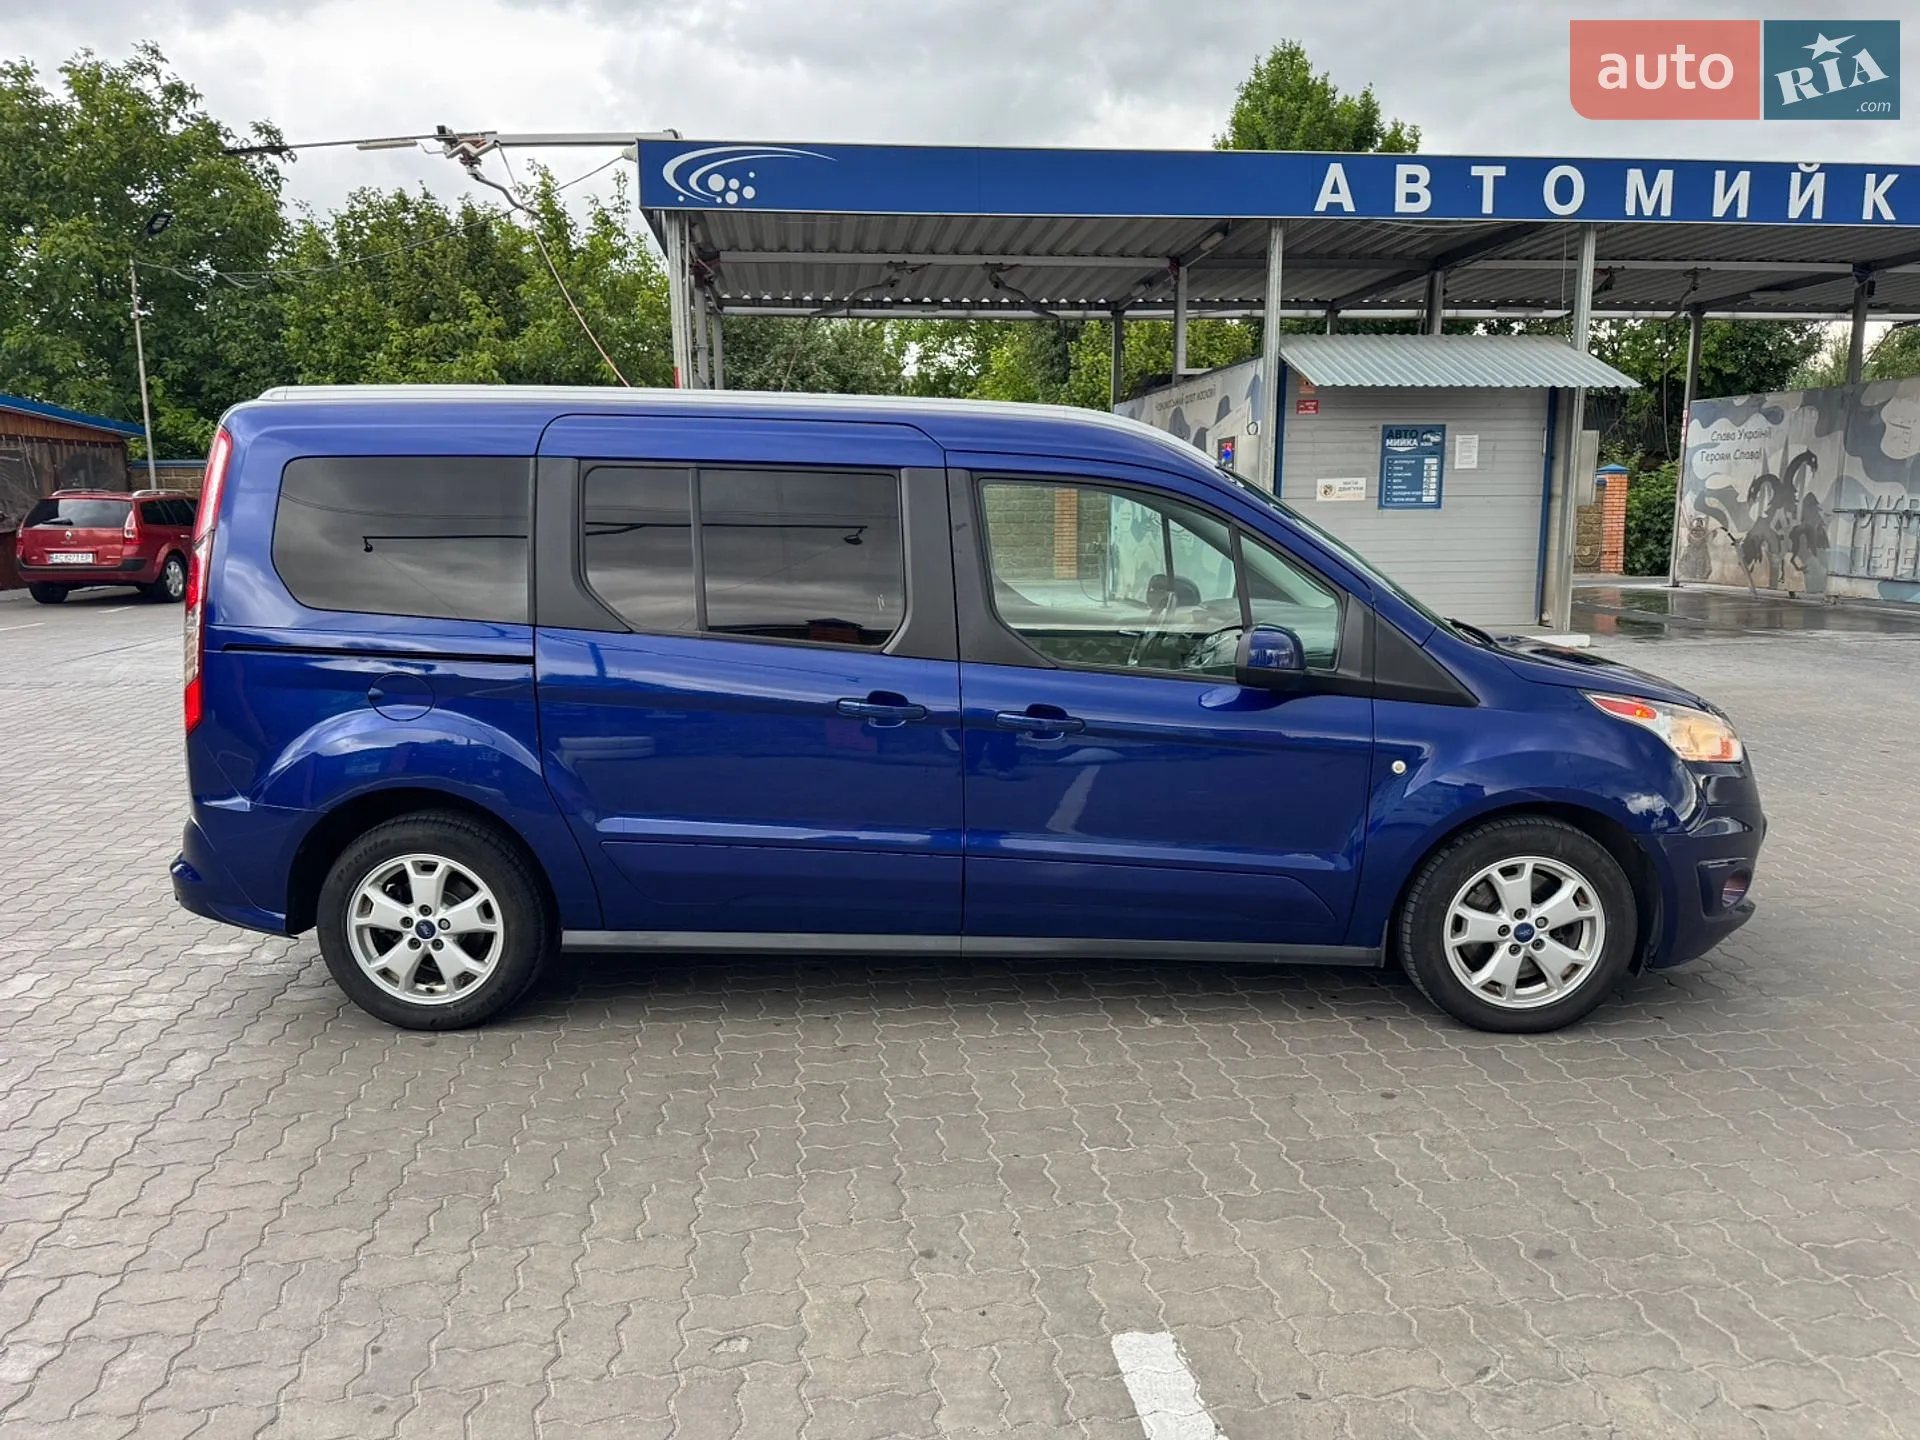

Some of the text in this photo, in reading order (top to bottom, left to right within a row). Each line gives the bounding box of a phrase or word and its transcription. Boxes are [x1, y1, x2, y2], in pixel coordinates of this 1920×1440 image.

[1386, 429, 1419, 440] АВТО
[1711, 430, 1736, 442] Слава
[1701, 450, 1732, 464] Героям
